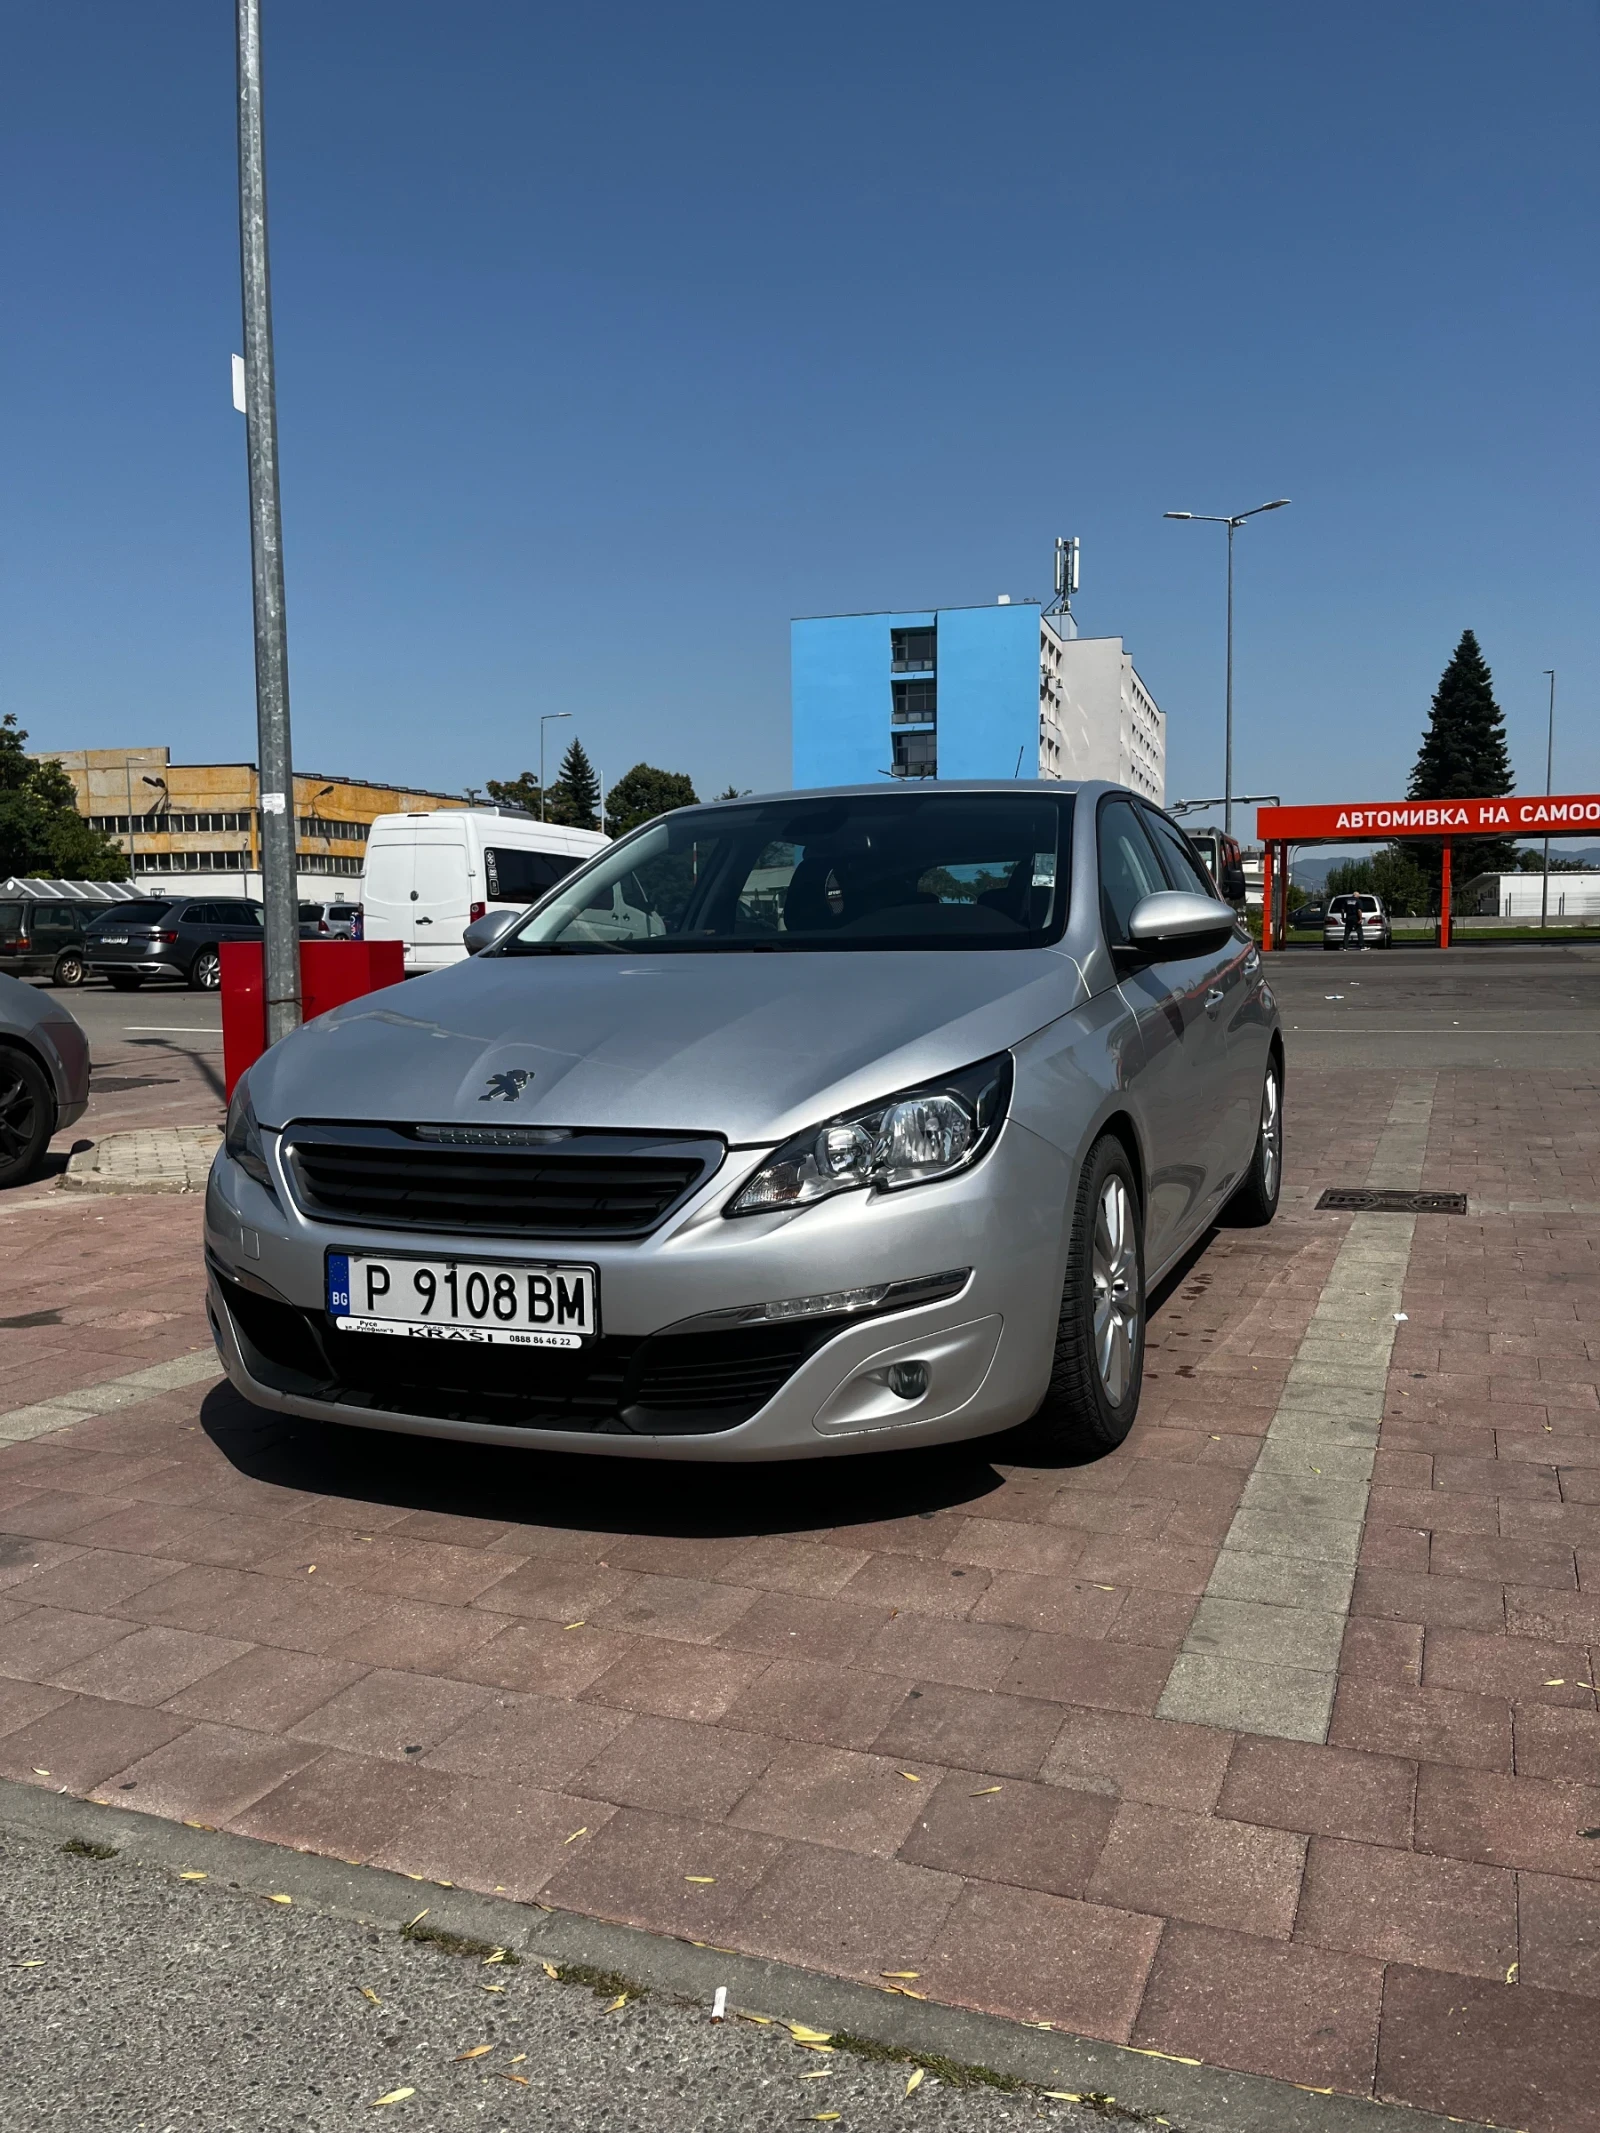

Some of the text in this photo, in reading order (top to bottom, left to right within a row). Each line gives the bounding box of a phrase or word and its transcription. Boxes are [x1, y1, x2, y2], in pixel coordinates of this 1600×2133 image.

[1336, 803, 1600, 829] АВТОМИВКА НА САМОО
[366, 1264, 391, 1311] P
[332, 1291, 348, 1306] BG
[408, 1327, 493, 1343] KRASI
[509, 1334, 531, 1343] 0888
[546, 1337, 557, 1345] 46
[559, 1338, 571, 1346] 22
